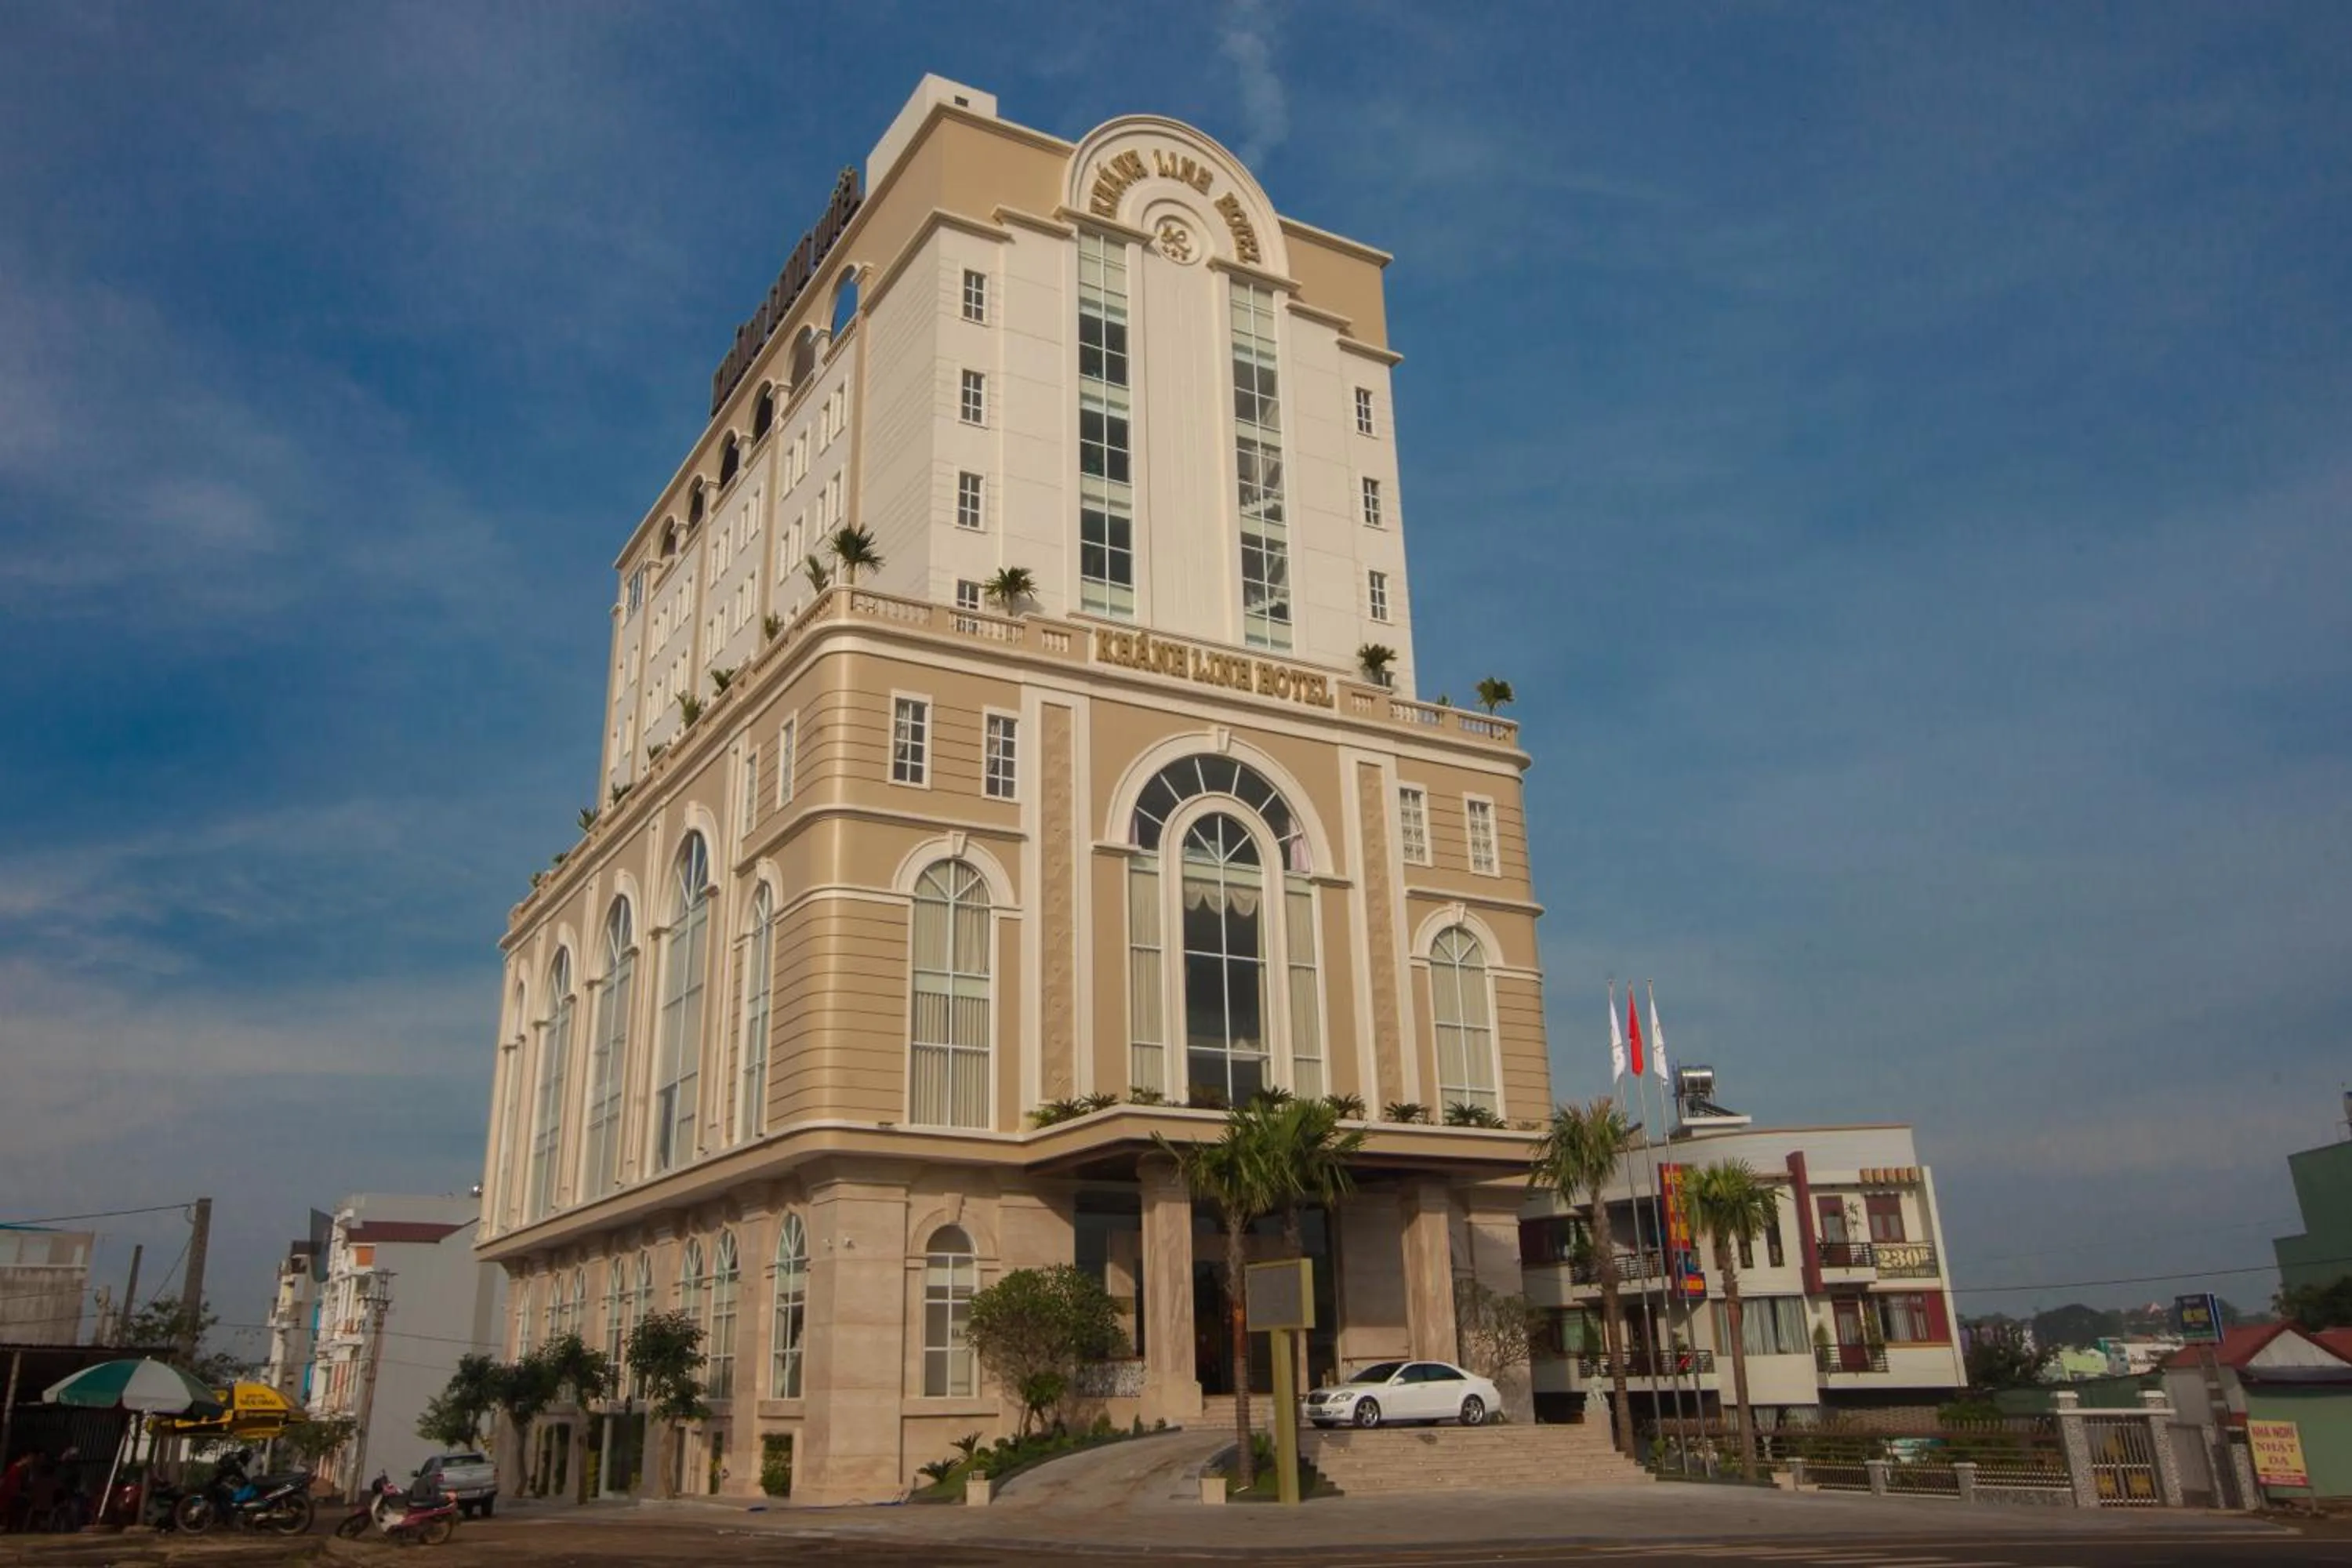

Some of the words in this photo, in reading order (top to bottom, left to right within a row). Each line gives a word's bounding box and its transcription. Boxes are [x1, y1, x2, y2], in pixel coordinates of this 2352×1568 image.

[1153, 148, 1214, 196] LINH
[1214, 191, 1261, 264] HOTEL
[1095, 626, 1189, 680] KHÁNH
[1192, 648, 1254, 691] LINH
[1257, 661, 1334, 708] HOTEL
